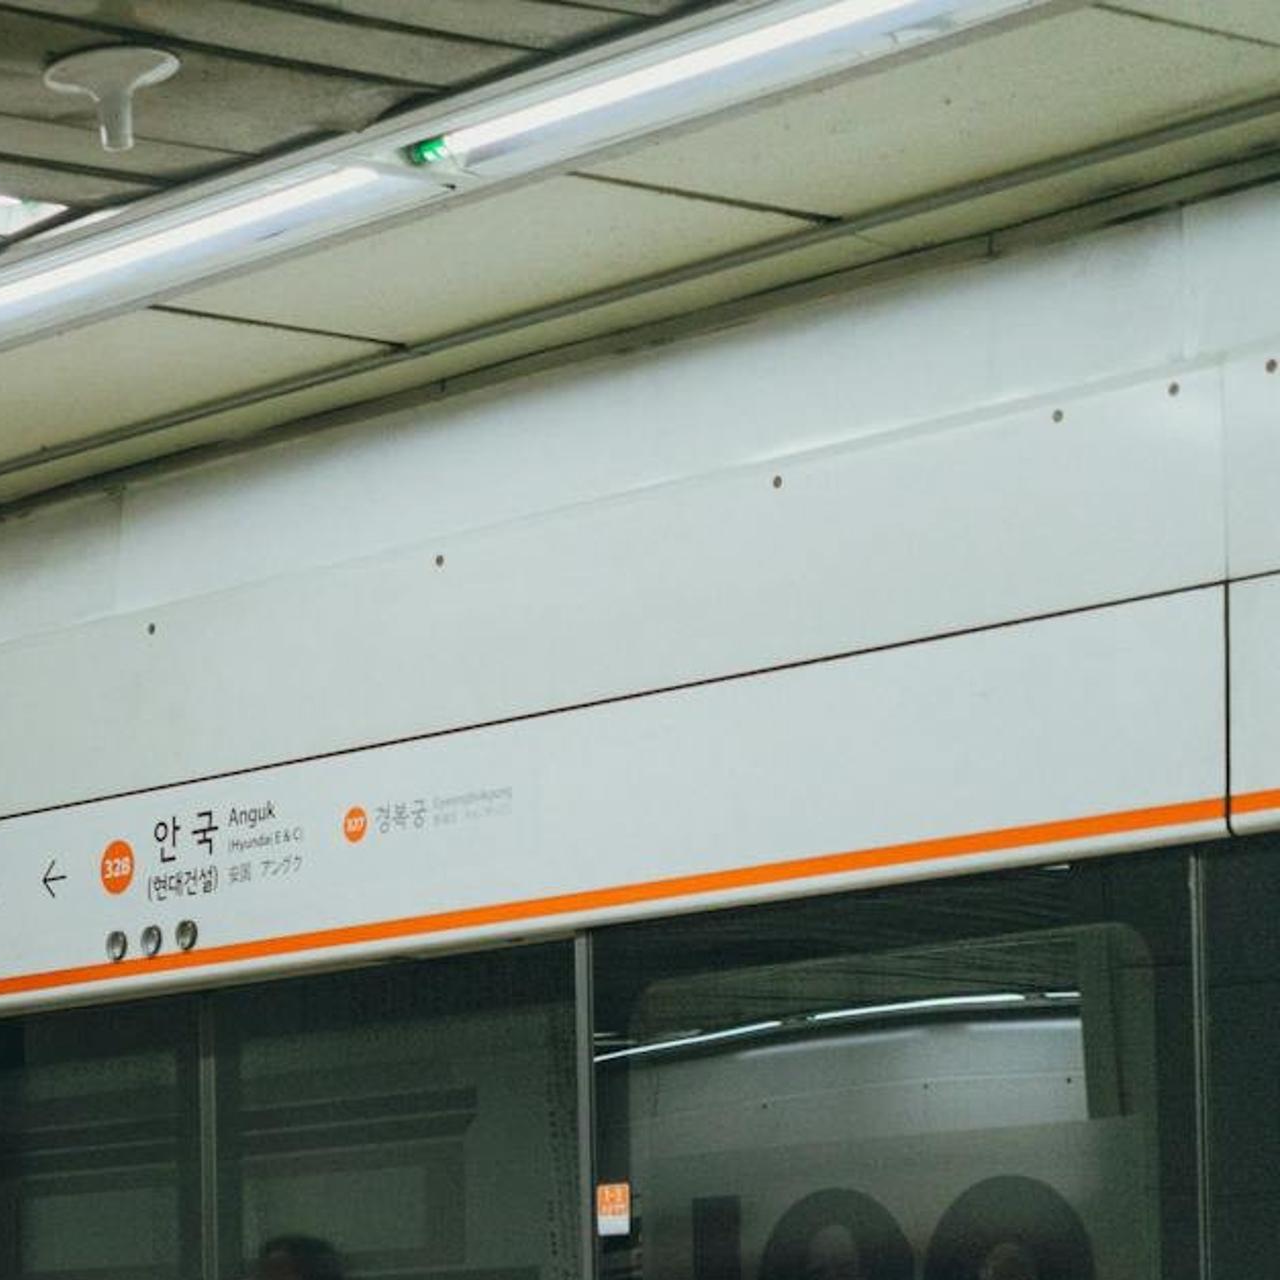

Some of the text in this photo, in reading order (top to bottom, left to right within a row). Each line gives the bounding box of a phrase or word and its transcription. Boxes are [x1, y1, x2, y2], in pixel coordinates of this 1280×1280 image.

[228, 801, 276, 828] Anguk
[375, 799, 427, 834] 경복궁
[104, 857, 129, 878] 328
[147, 865, 219, 901] (현대건설)
